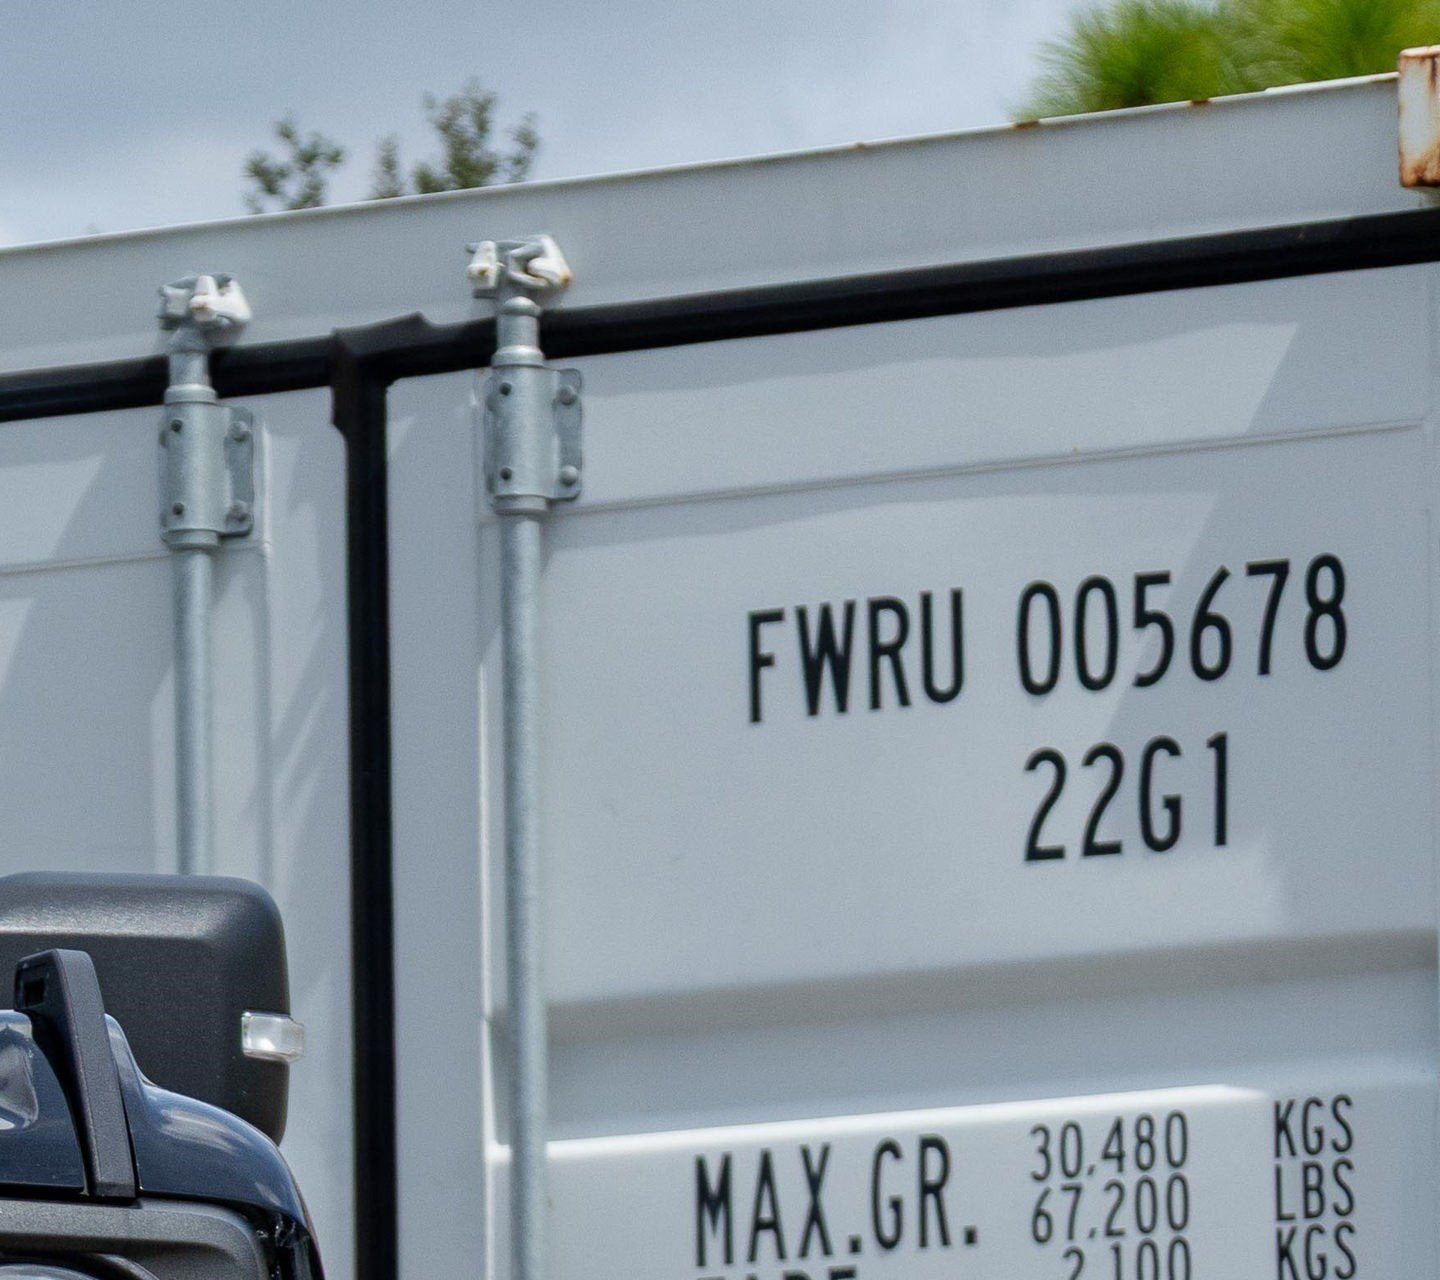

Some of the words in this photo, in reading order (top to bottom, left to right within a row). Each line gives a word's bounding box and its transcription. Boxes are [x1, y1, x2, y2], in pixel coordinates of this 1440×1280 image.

[747, 587, 965, 723] FWRU
[1016, 552, 1348, 698] 005678
[1023, 730, 1230, 862] 22G1
[694, 1134, 980, 1268] MAX.GR.
[1030, 1109, 1188, 1182] 30,480
[1274, 1096, 1354, 1158] KGS
[1031, 1171, 1190, 1244] 67,200
[1275, 1157, 1355, 1222] LBS
